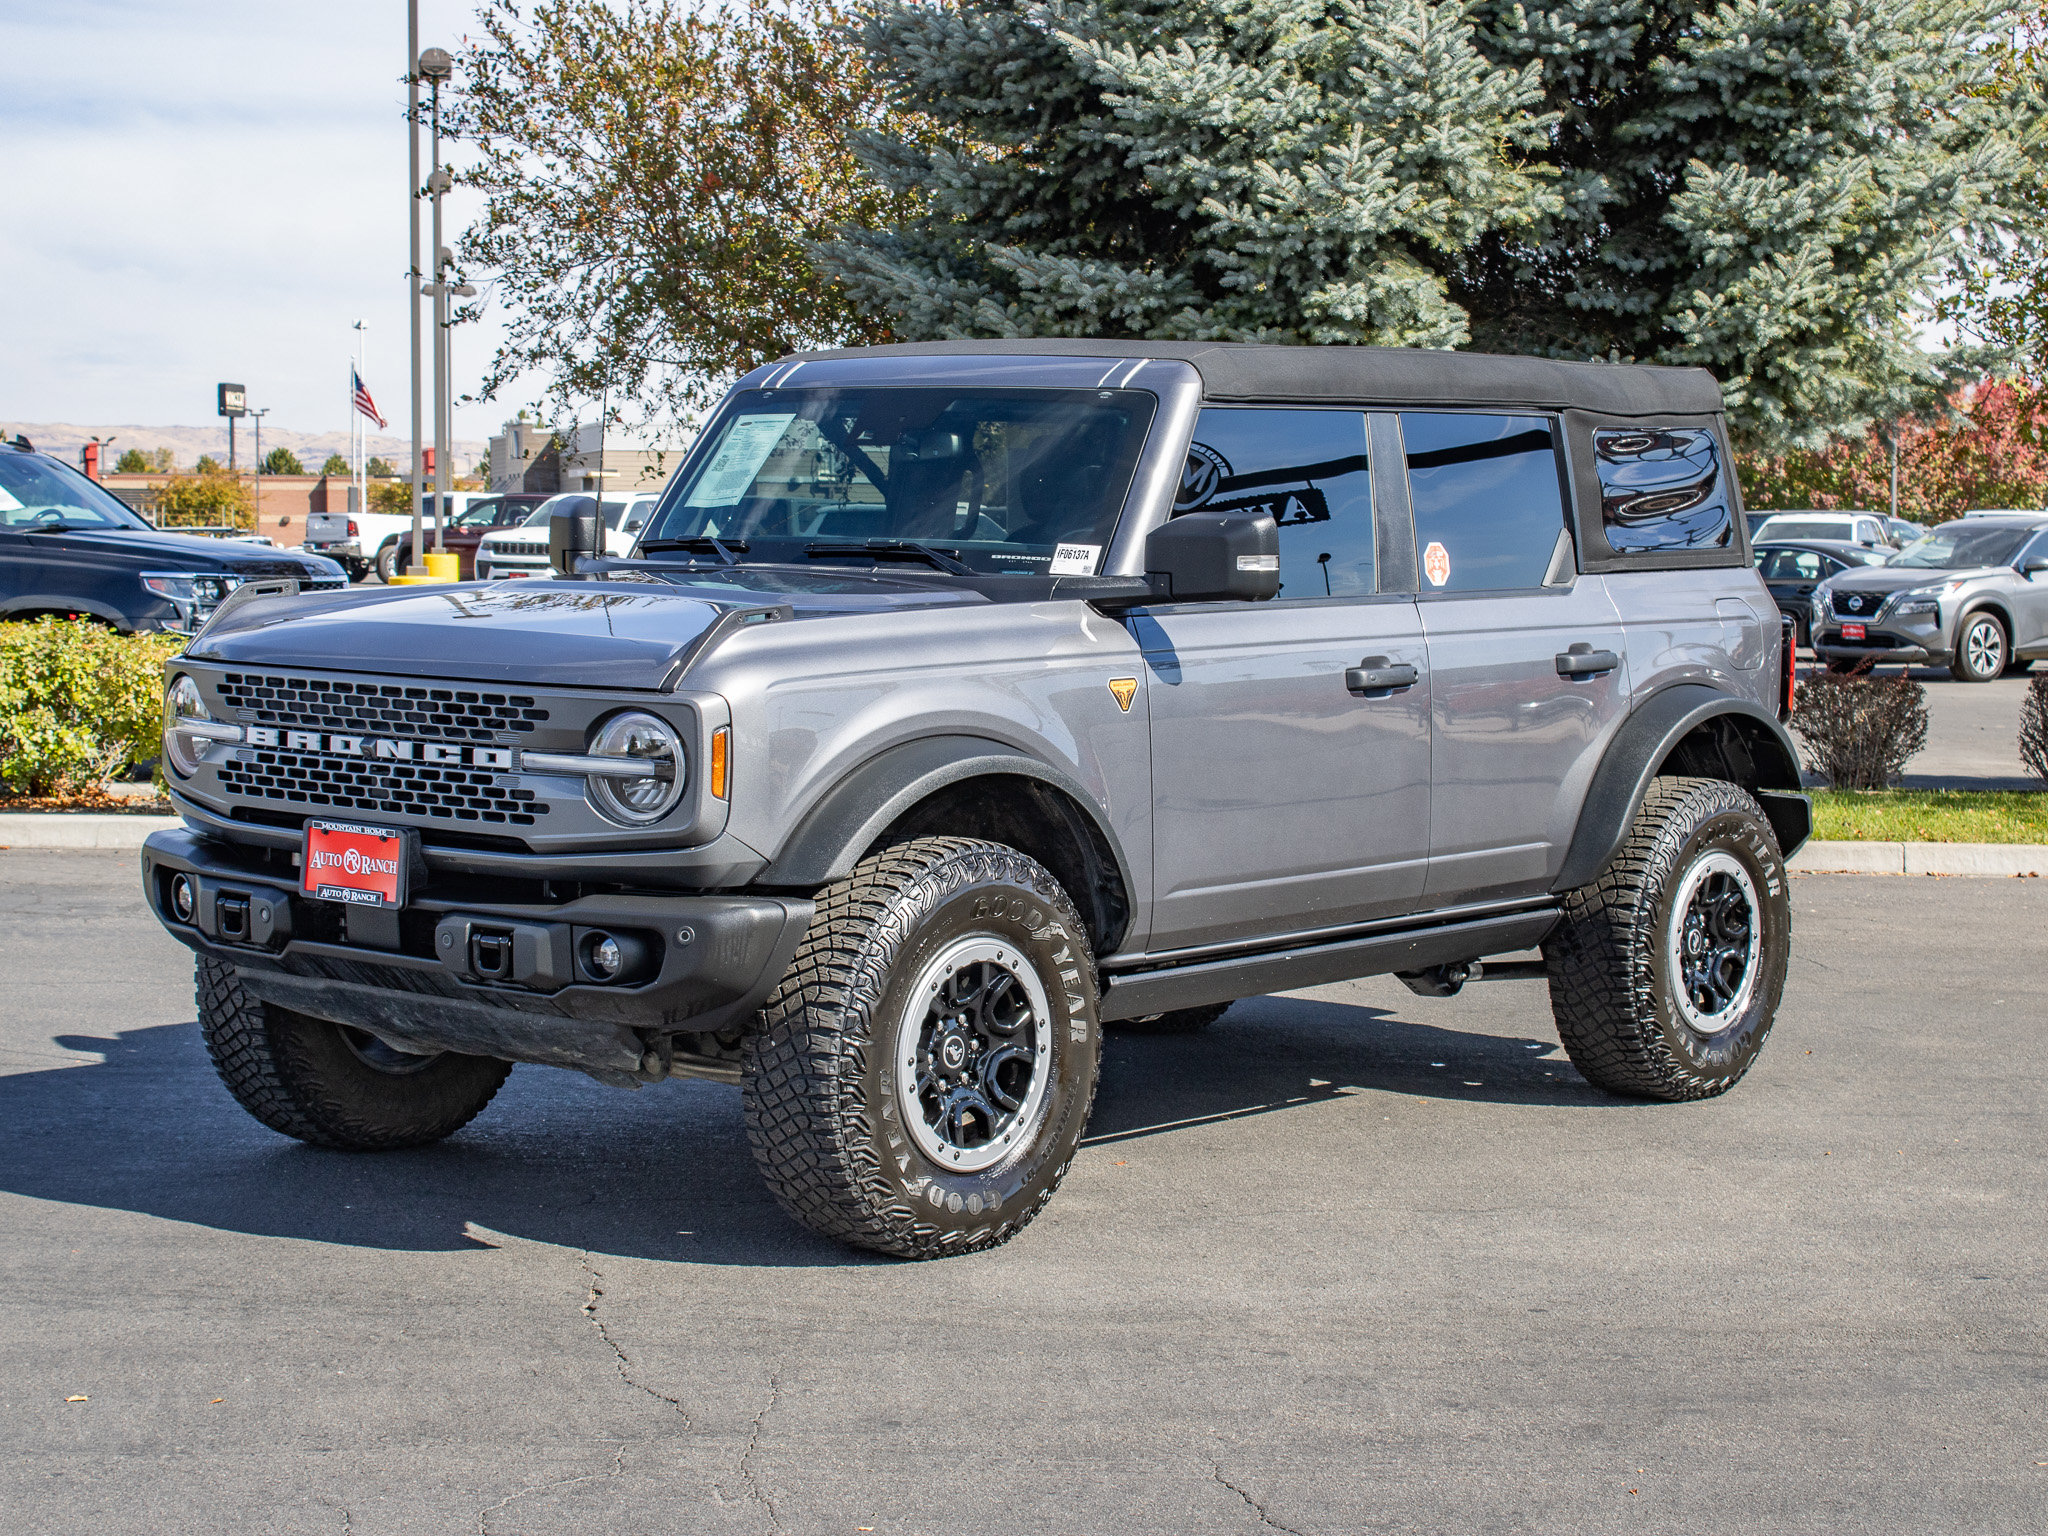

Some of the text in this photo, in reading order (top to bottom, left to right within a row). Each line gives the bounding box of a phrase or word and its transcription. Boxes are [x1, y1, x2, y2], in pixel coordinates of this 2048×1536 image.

[247, 726, 512, 768] BRONCO
[322, 821, 387, 836] MOUNTAIN HOME
[310, 850, 397, 875] AUTO RANCH
[320, 888, 377, 902] AUTO RANCH
